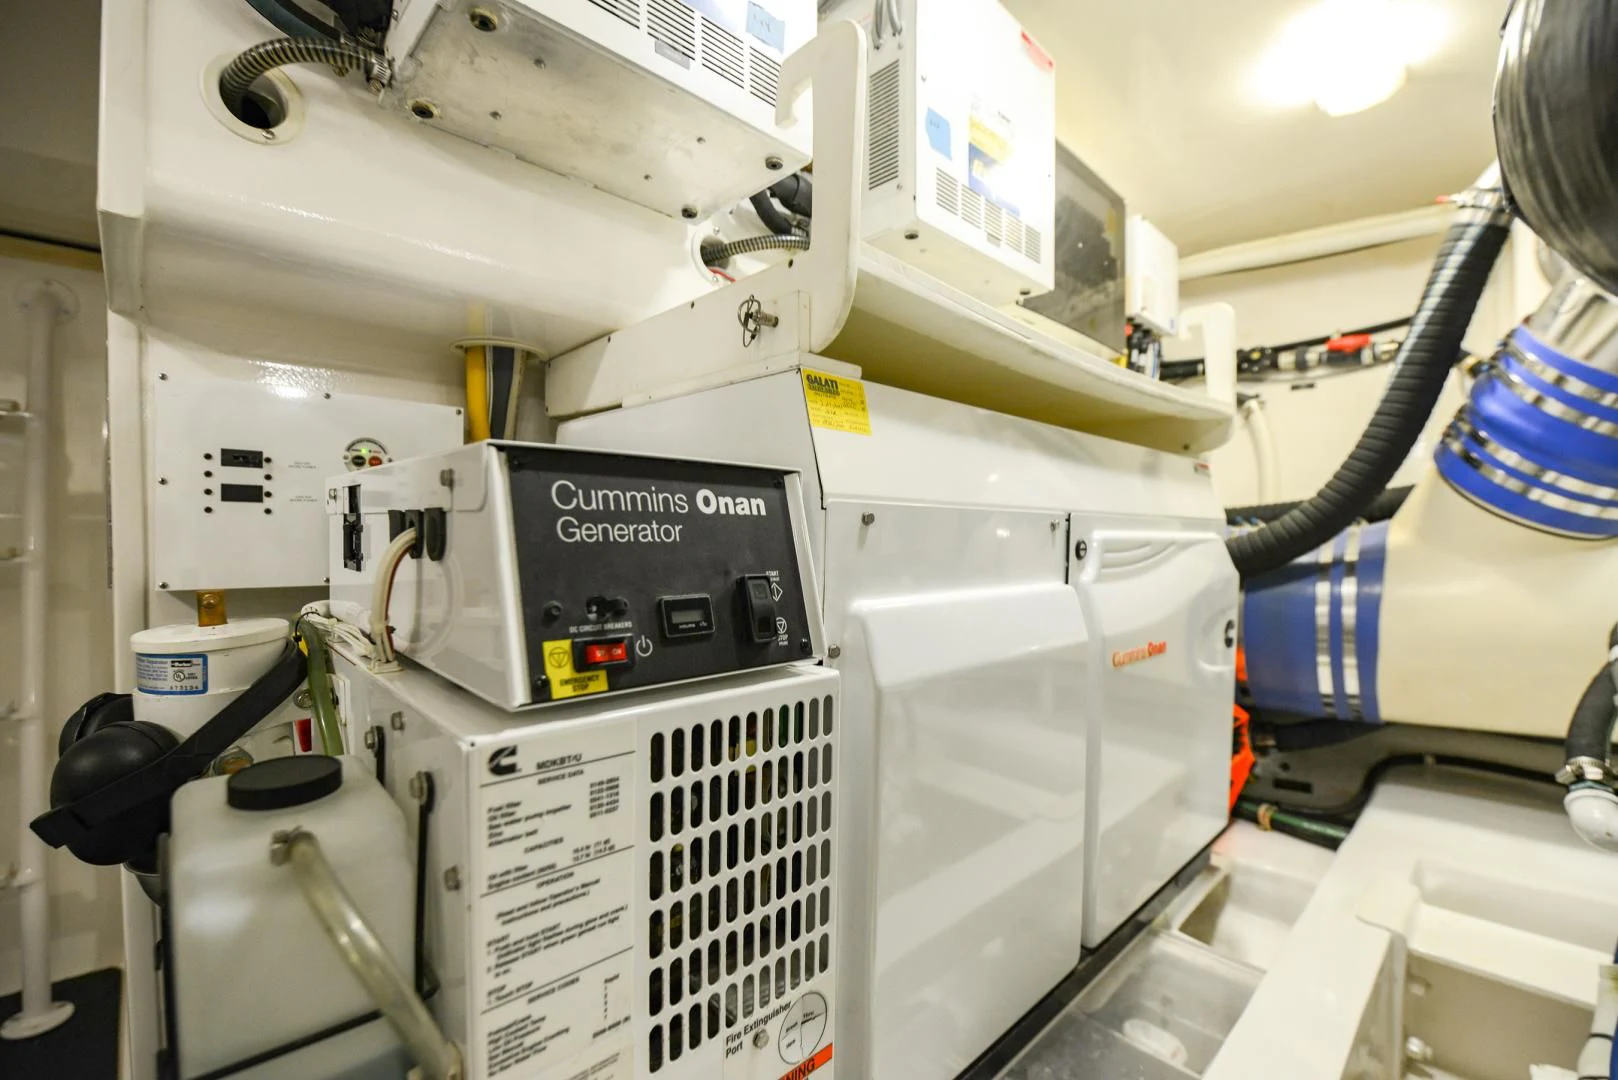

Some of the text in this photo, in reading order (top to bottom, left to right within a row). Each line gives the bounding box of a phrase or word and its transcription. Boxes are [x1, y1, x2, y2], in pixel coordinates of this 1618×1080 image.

[806, 374, 839, 390] GALATI
[551, 480, 767, 516] Cummins Onan
[556, 516, 683, 543] Generator
[579, 623, 602, 632] CIRCUIT
[726, 1001, 791, 1046] Fire Extinguisher
[726, 1041, 743, 1059] Port
